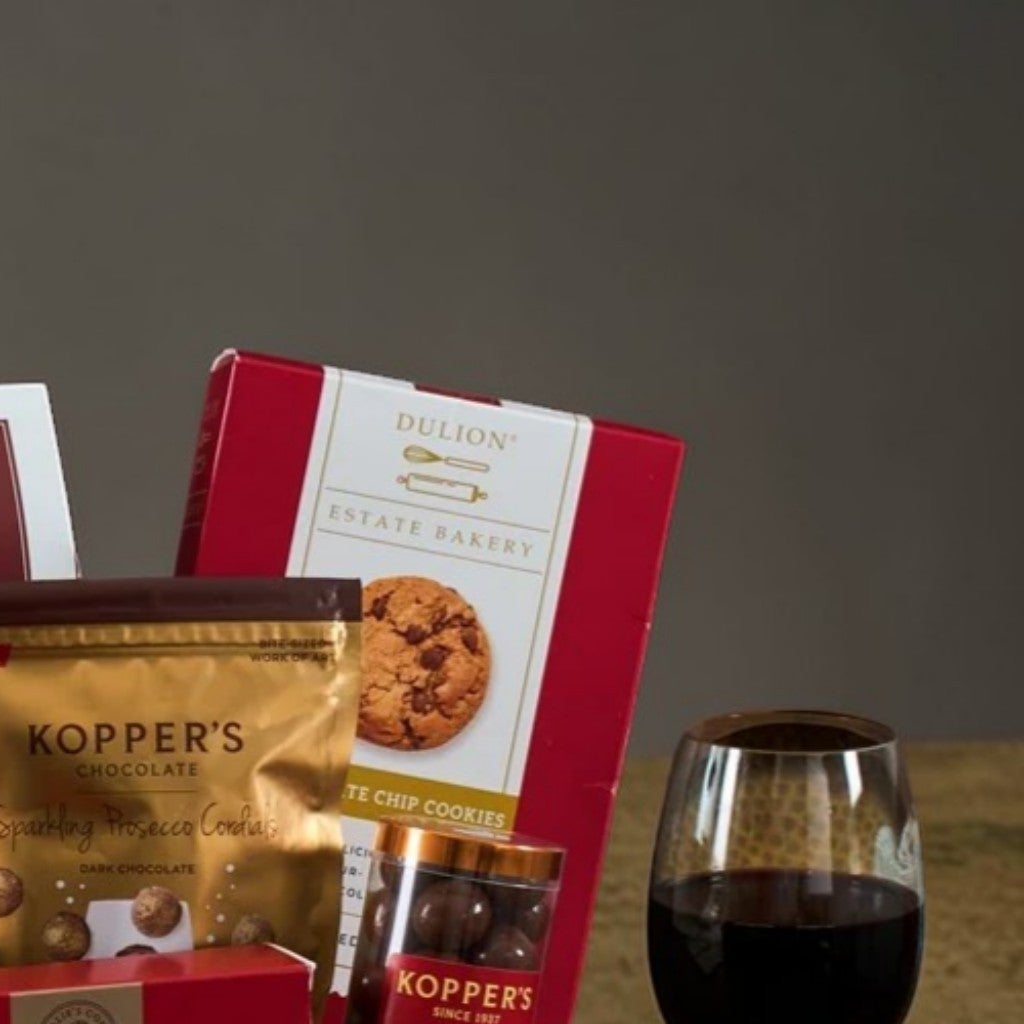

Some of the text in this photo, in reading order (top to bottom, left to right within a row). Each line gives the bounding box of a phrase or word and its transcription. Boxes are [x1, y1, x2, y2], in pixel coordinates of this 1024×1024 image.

[396, 412, 507, 450] DULION
[329, 504, 536, 558] ESTATE BAKERY
[27, 721, 245, 756] KOPPER'S
[76, 761, 199, 779] CHOCOLATE
[105, 803, 193, 840] Prosecco
[199, 801, 278, 840] Cordials
[374, 789, 419, 812] CHIP
[423, 800, 506, 829] COOKIES
[80, 863, 196, 875] DARK CHOCOLATE
[396, 969, 534, 1011] KOPPER'S
[432, 1006, 501, 1024] SINCE 1937
